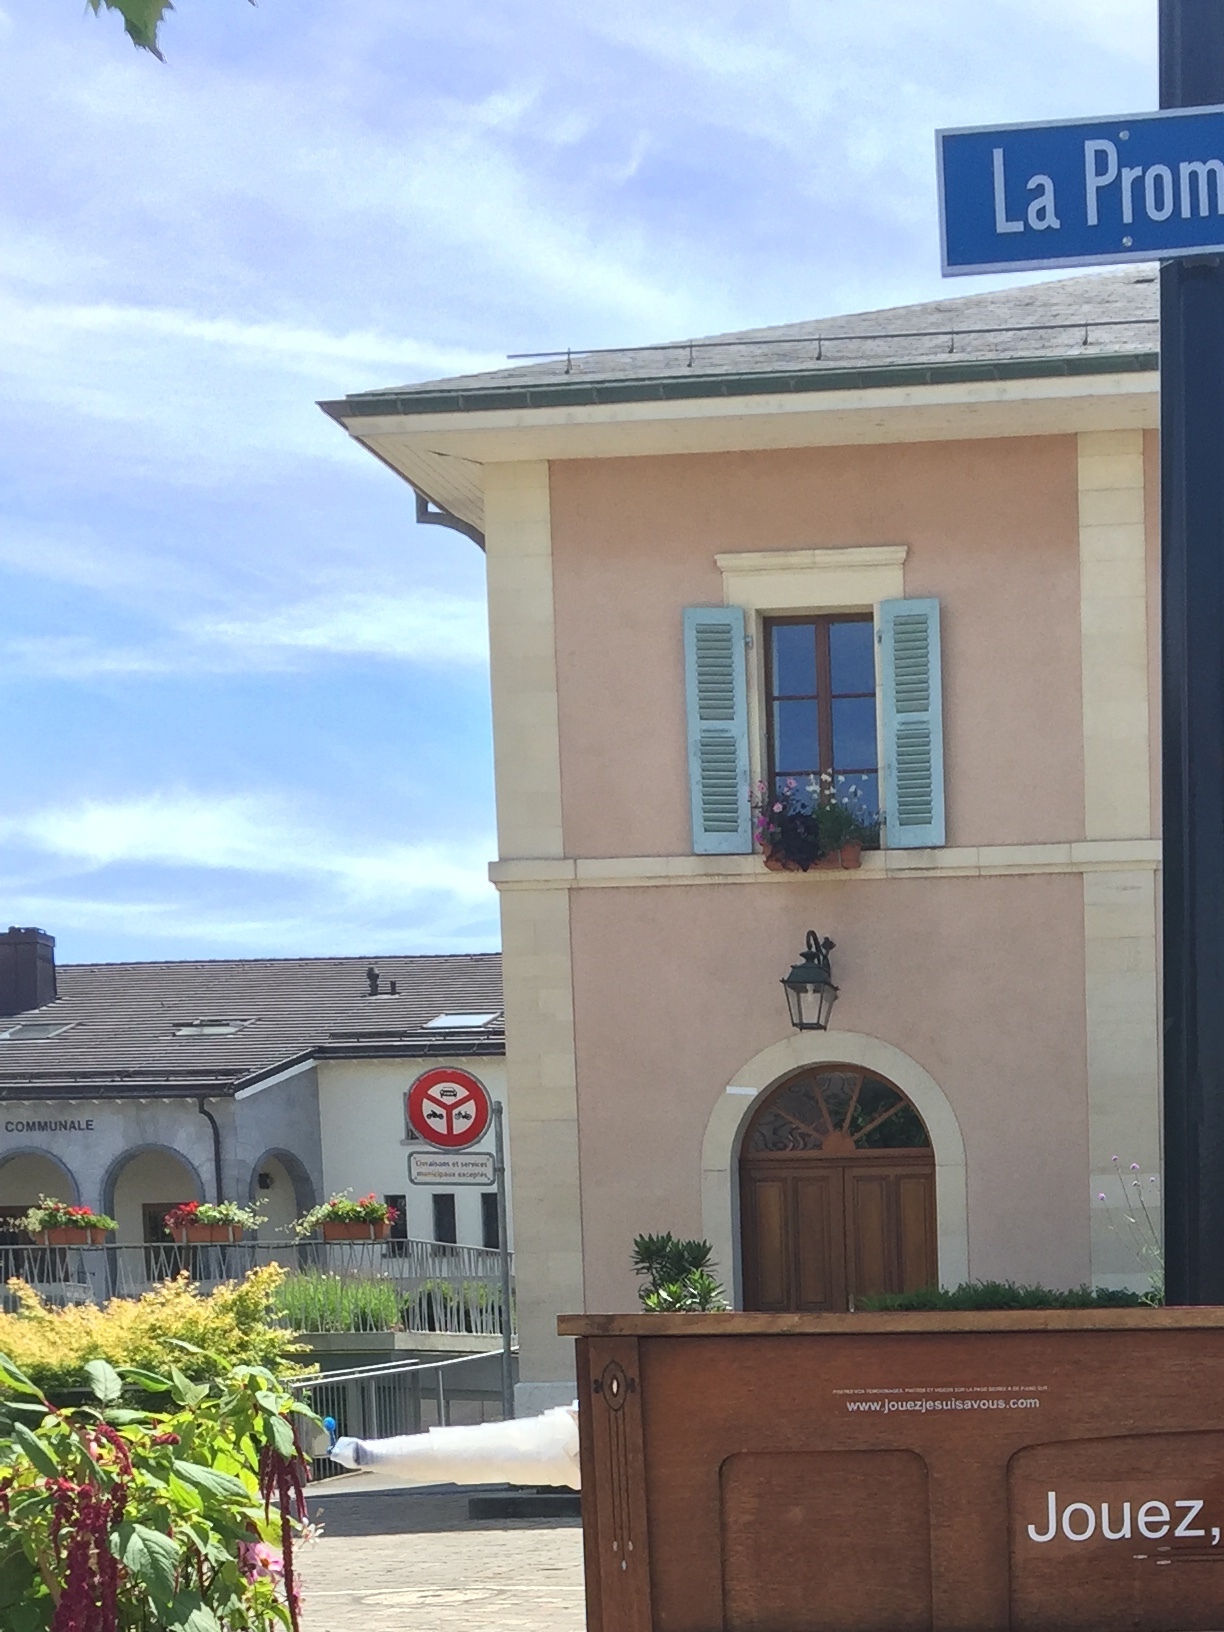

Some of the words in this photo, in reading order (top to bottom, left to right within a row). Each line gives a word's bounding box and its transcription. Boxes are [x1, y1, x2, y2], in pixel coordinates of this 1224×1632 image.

[993, 148, 1060, 233] La
[5, 1120, 94, 1132] COMMUNALE
[847, 1397, 1039, 1413] www.jouezjesuisavous.com
[1028, 1491, 1221, 1545] Jouez,
